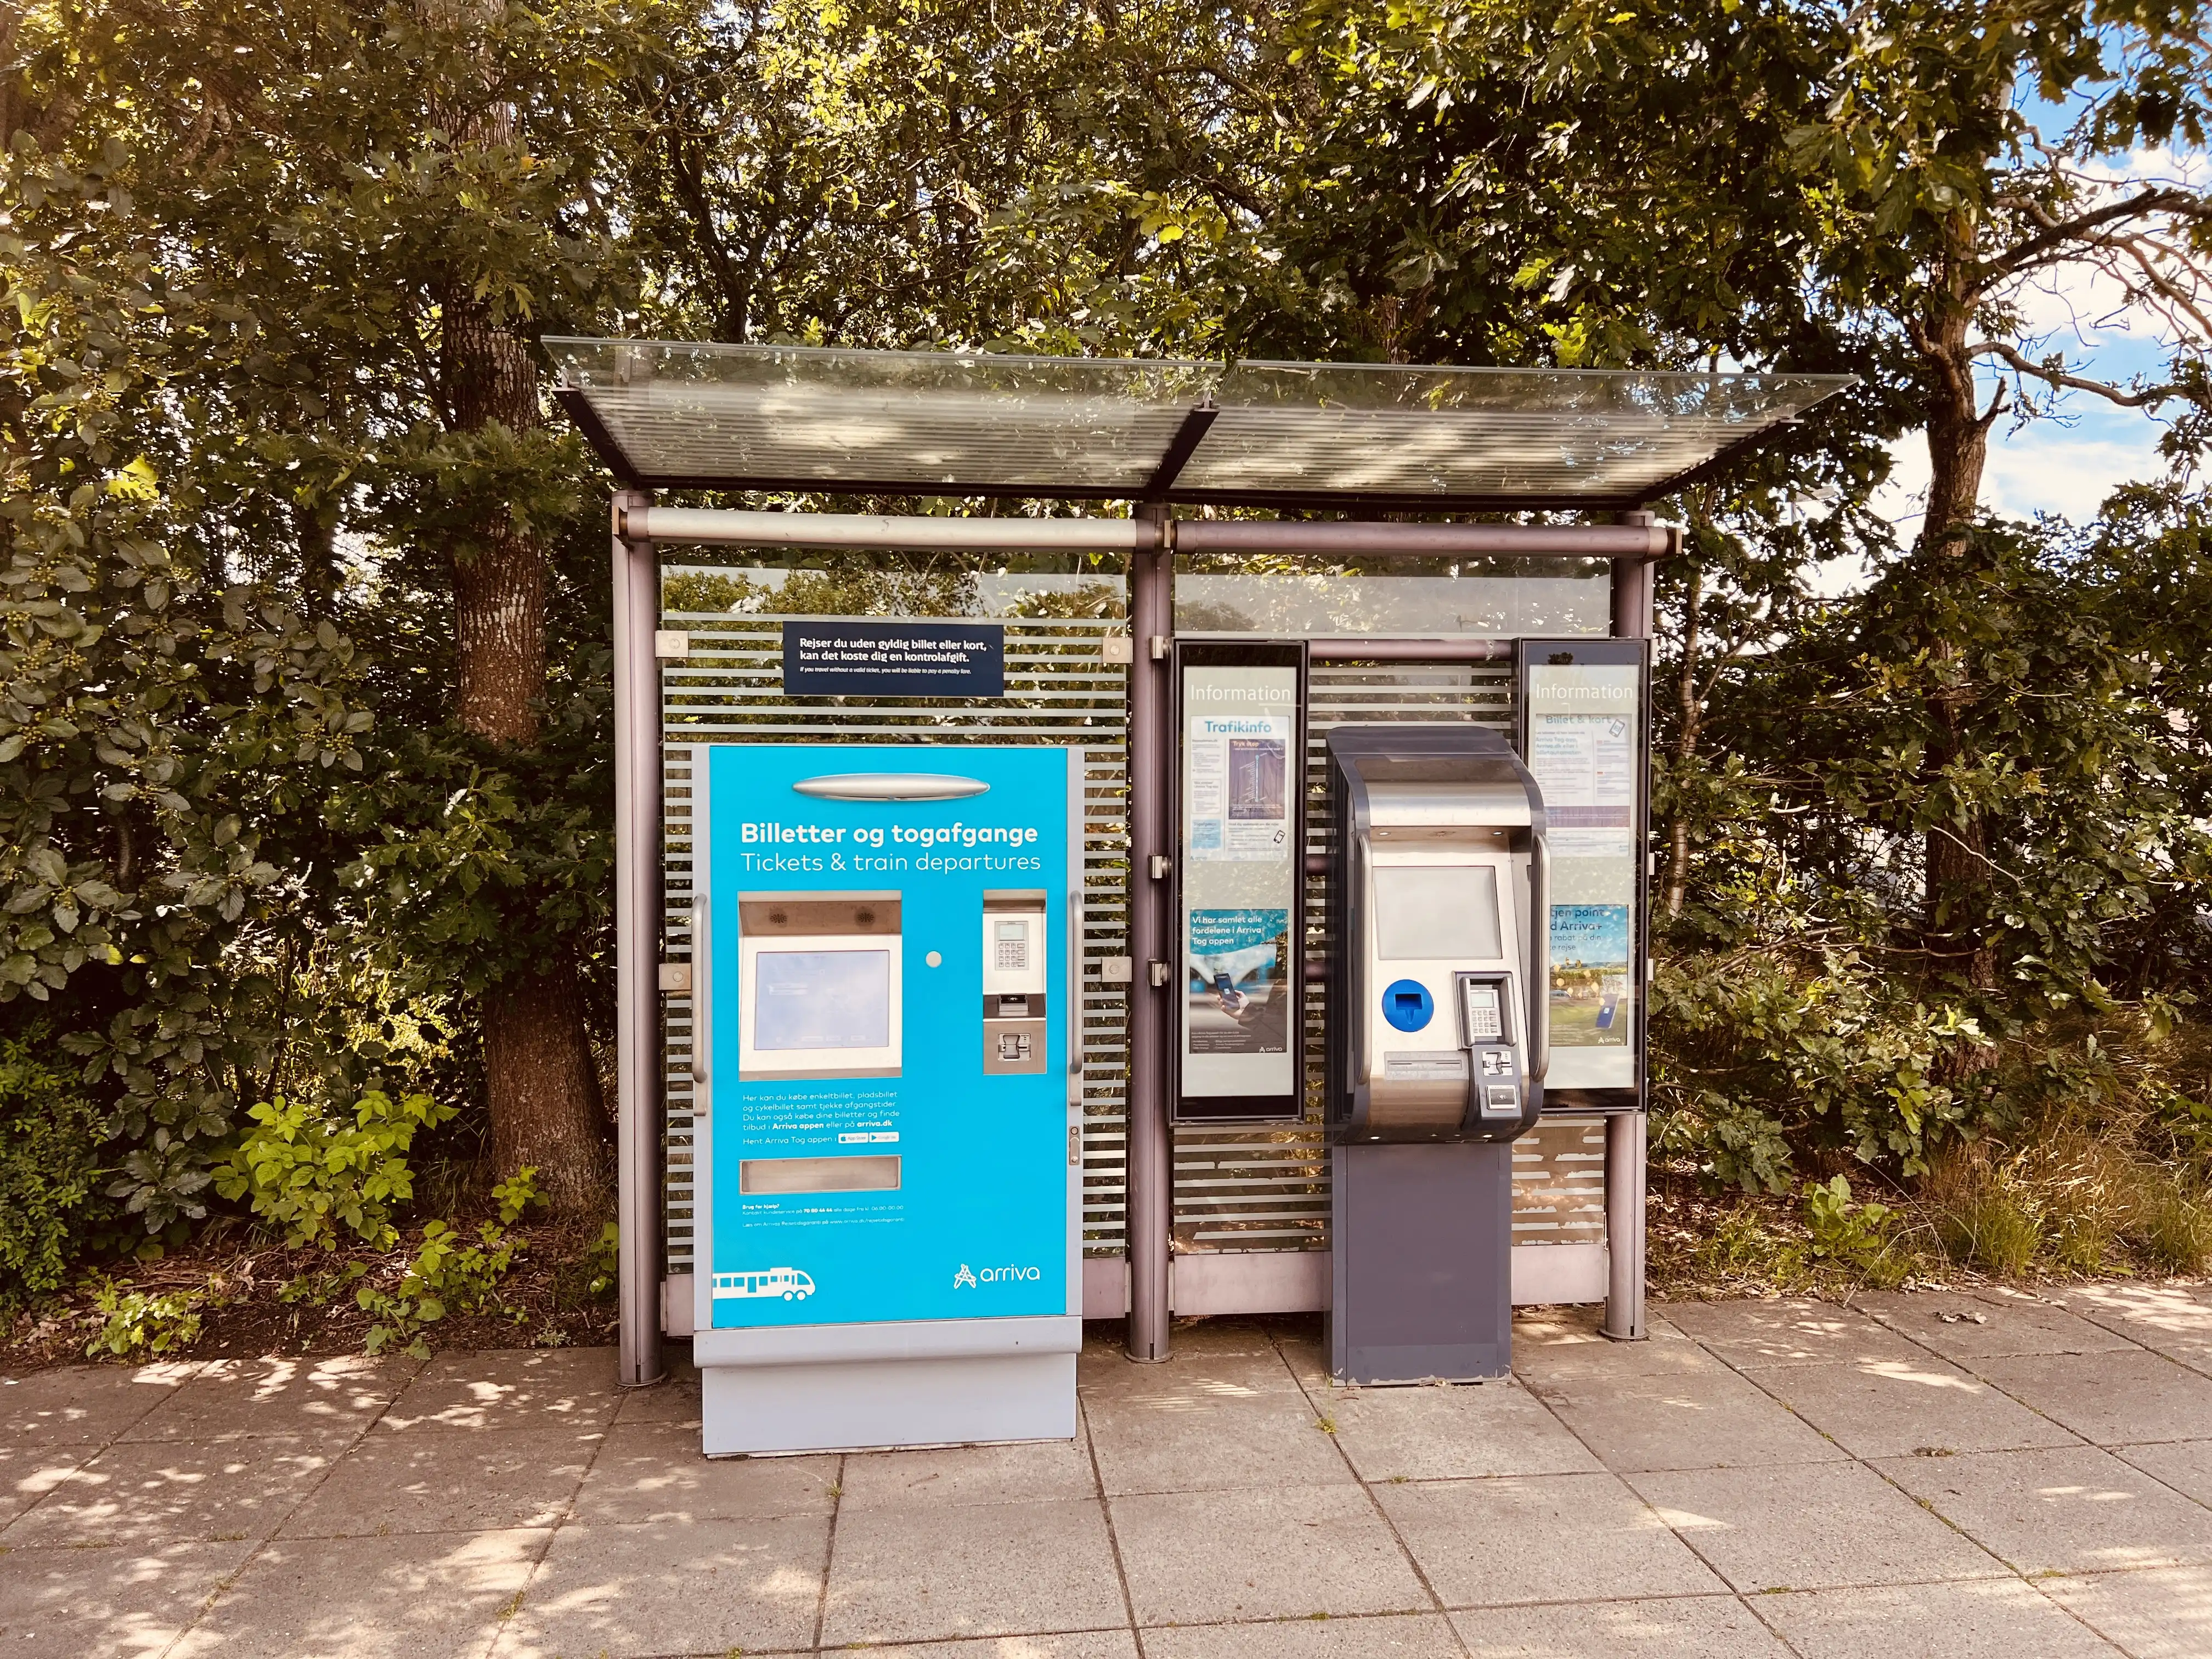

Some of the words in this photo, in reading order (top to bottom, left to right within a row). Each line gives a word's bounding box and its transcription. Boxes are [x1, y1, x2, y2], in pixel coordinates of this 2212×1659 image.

[800, 638, 832, 649] Rejser
[834, 638, 848, 648] du
[850, 639, 876, 648] uden
[878, 639, 909, 651] gyldig
[911, 639, 937, 650] billet
[939, 640, 961, 650] eller
[963, 640, 987, 651] kort,
[800, 650, 819, 660] kan
[821, 651, 838, 660] det
[841, 651, 868, 661] koste
[871, 651, 888, 662] dig
[905, 652, 969, 663] kontrolafgift.
[1191, 685, 1290, 701] Information
[1536, 683, 1633, 699] Information
[1546, 715, 1574, 724] Billet
[1577, 715, 1585, 724] &
[1589, 715, 1612, 724] kort
[1204, 721, 1272, 732] Trafikinfo
[741, 823, 846, 843] Billetter
[854, 827, 884, 847] og
[892, 822, 1038, 848] togafgange
[741, 853, 823, 871] Tickets
[831, 853, 846, 871] &
[854, 853, 908, 871] train
[916, 853, 1040, 874] departures
[1551, 909, 1571, 919] tjen
[1575, 908, 1604, 918] point
[1560, 921, 1602, 930] Arriva+
[1559, 944, 1576, 952] rejse
[857, 1091, 898, 1099] pladsbillet
[819, 1102, 843, 1110] tjekke
[845, 1101, 896, 1109] afgangstider
[773, 1113, 792, 1121] også
[845, 1120, 855, 1128] på
[980, 1263, 1040, 1282] arriva
